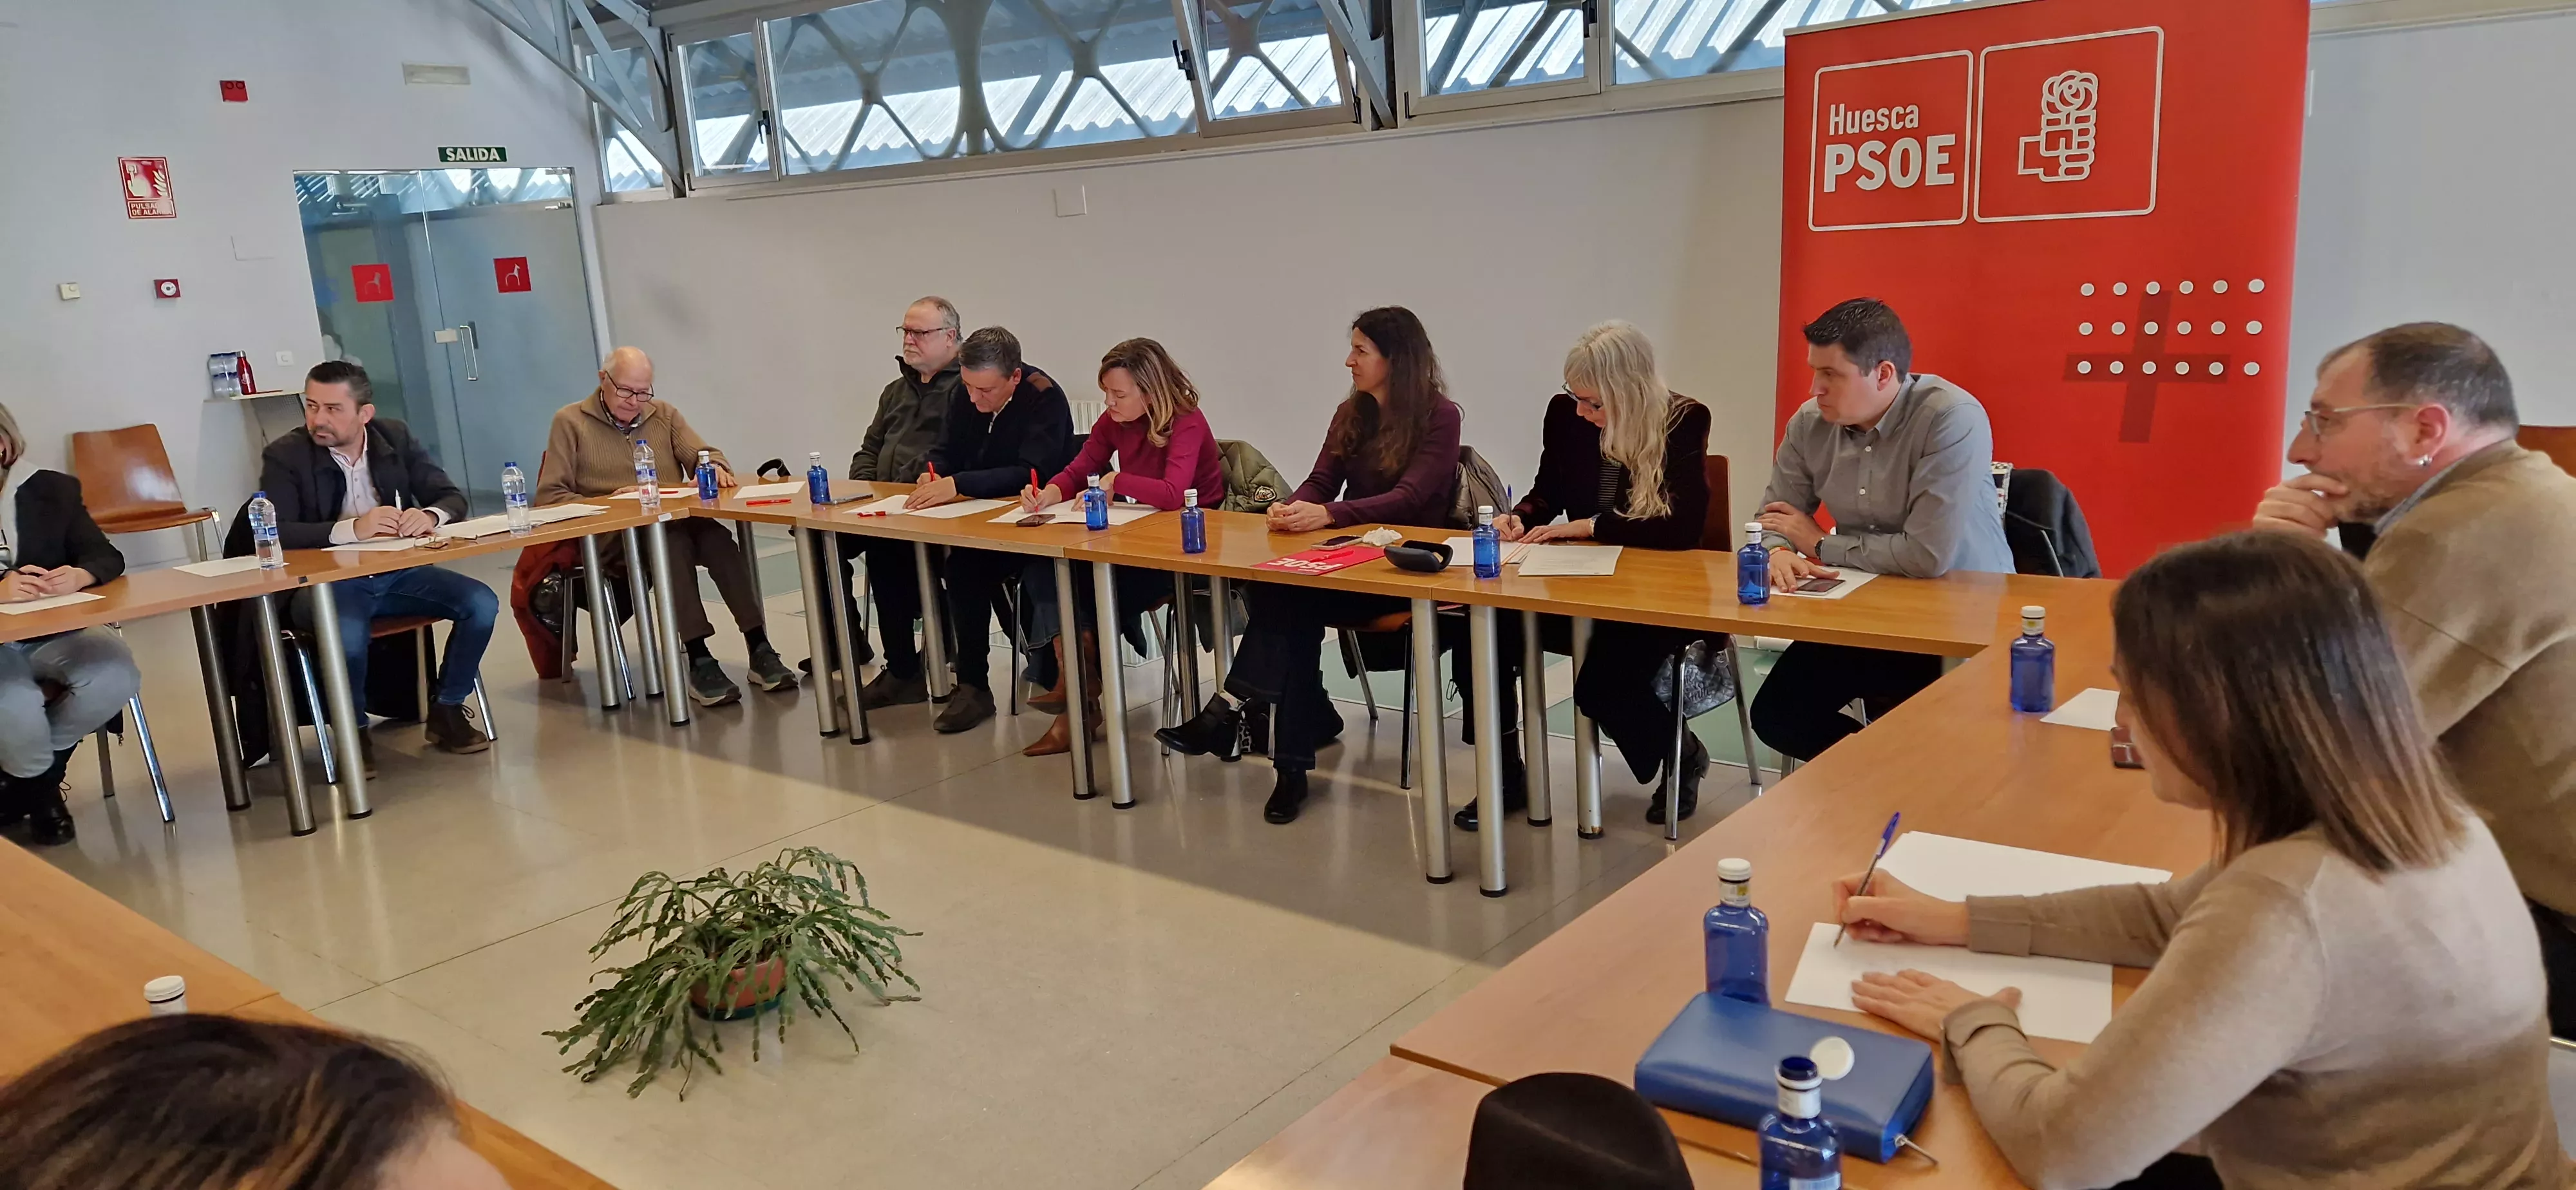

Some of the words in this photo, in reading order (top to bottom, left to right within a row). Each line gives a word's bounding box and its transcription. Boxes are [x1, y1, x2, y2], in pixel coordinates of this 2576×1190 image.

[1829, 104, 1919, 136] Huesca
[446, 147, 501, 162] SALIDA
[1824, 133, 1956, 193] PSOE
[1267, 558, 1343, 571] PSOE
